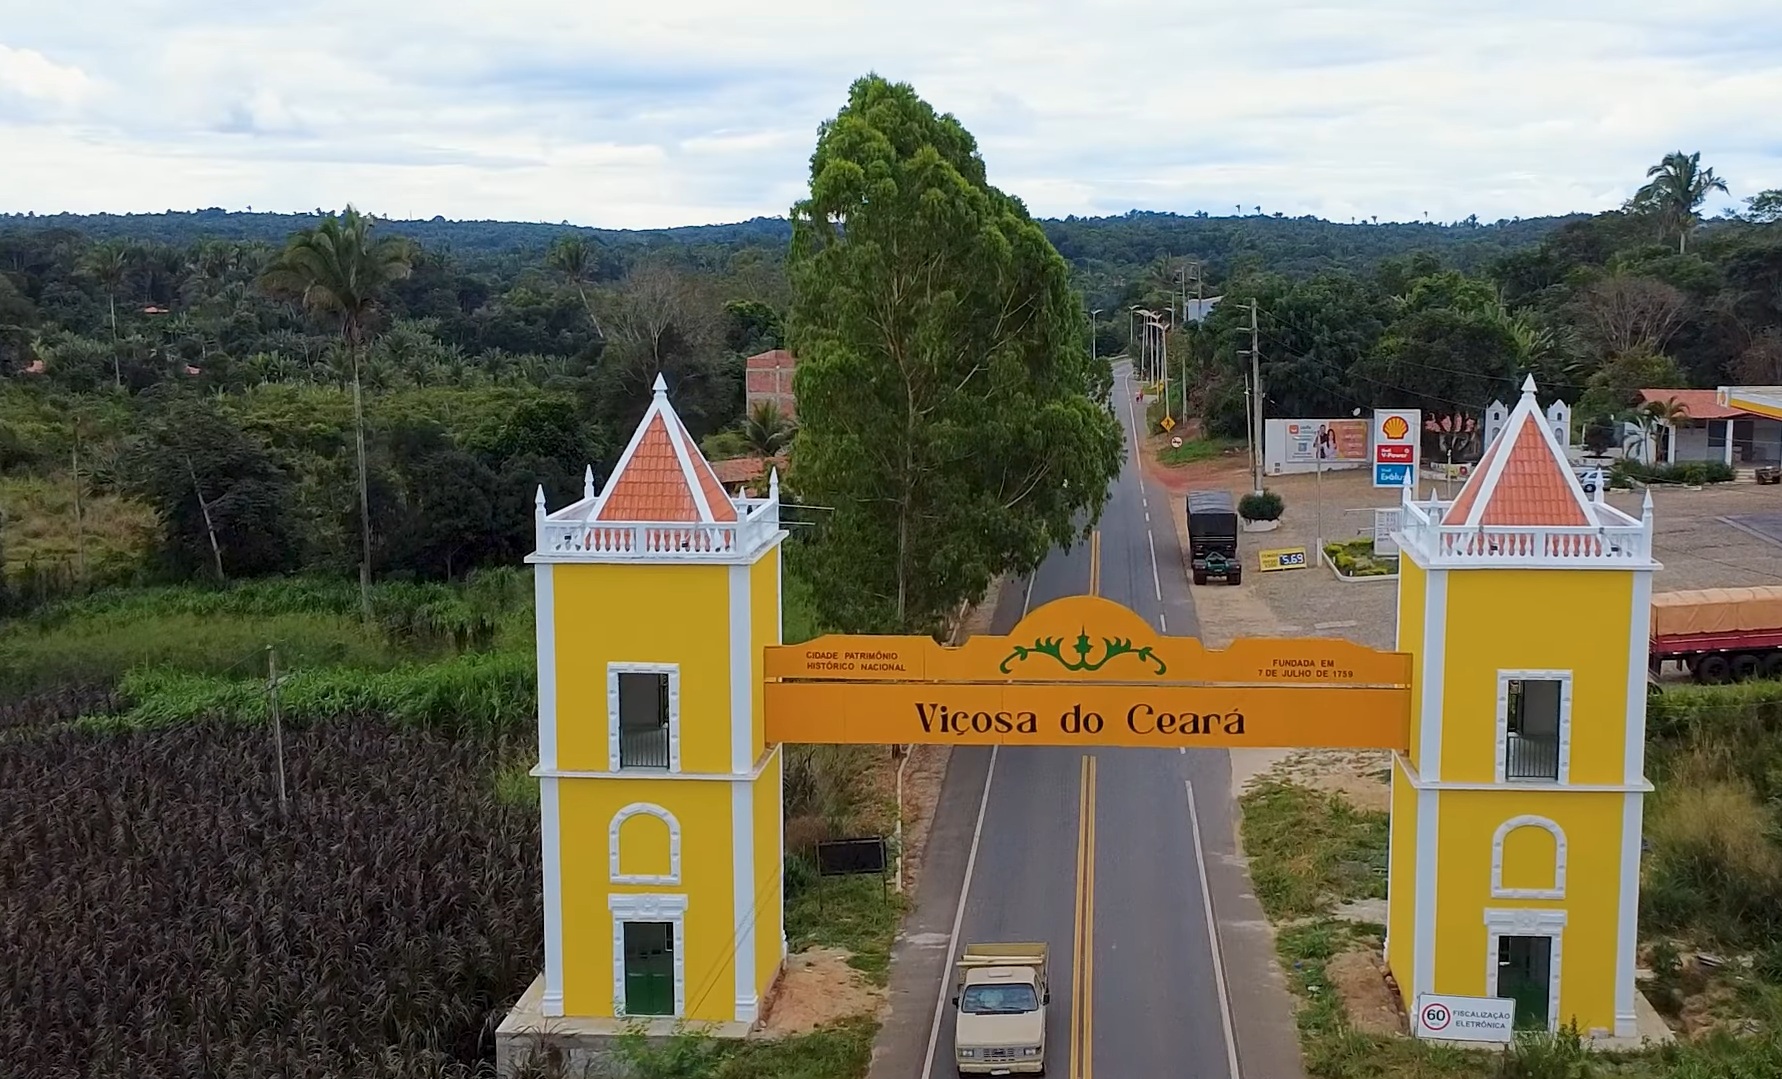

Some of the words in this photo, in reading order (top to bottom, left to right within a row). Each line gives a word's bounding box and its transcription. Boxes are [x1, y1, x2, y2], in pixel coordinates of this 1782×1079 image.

[806, 651, 838, 660] CIDADE
[844, 651, 898, 660] PATRIMÔNIO
[806, 661, 855, 671] HISTÓRICO
[860, 662, 906, 672] NACIONAL
[1272, 659, 1315, 667] FUNDADA
[1320, 659, 1334, 668] EM
[1258, 669, 1263, 677] 7
[1265, 669, 1277, 677] DE
[1281, 669, 1312, 678] JULHO
[1316, 670, 1328, 678] DE
[1332, 670, 1353, 678] 1759
[914, 703, 1038, 736] Viçosa
[1060, 703, 1104, 734] do
[1127, 703, 1245, 735] Ceará
[1426, 1009, 1446, 1021] 60
[1452, 1009, 1511, 1020] FISCALIZAÇÃO
[1455, 1020, 1506, 1029] ELETRÔNICA
